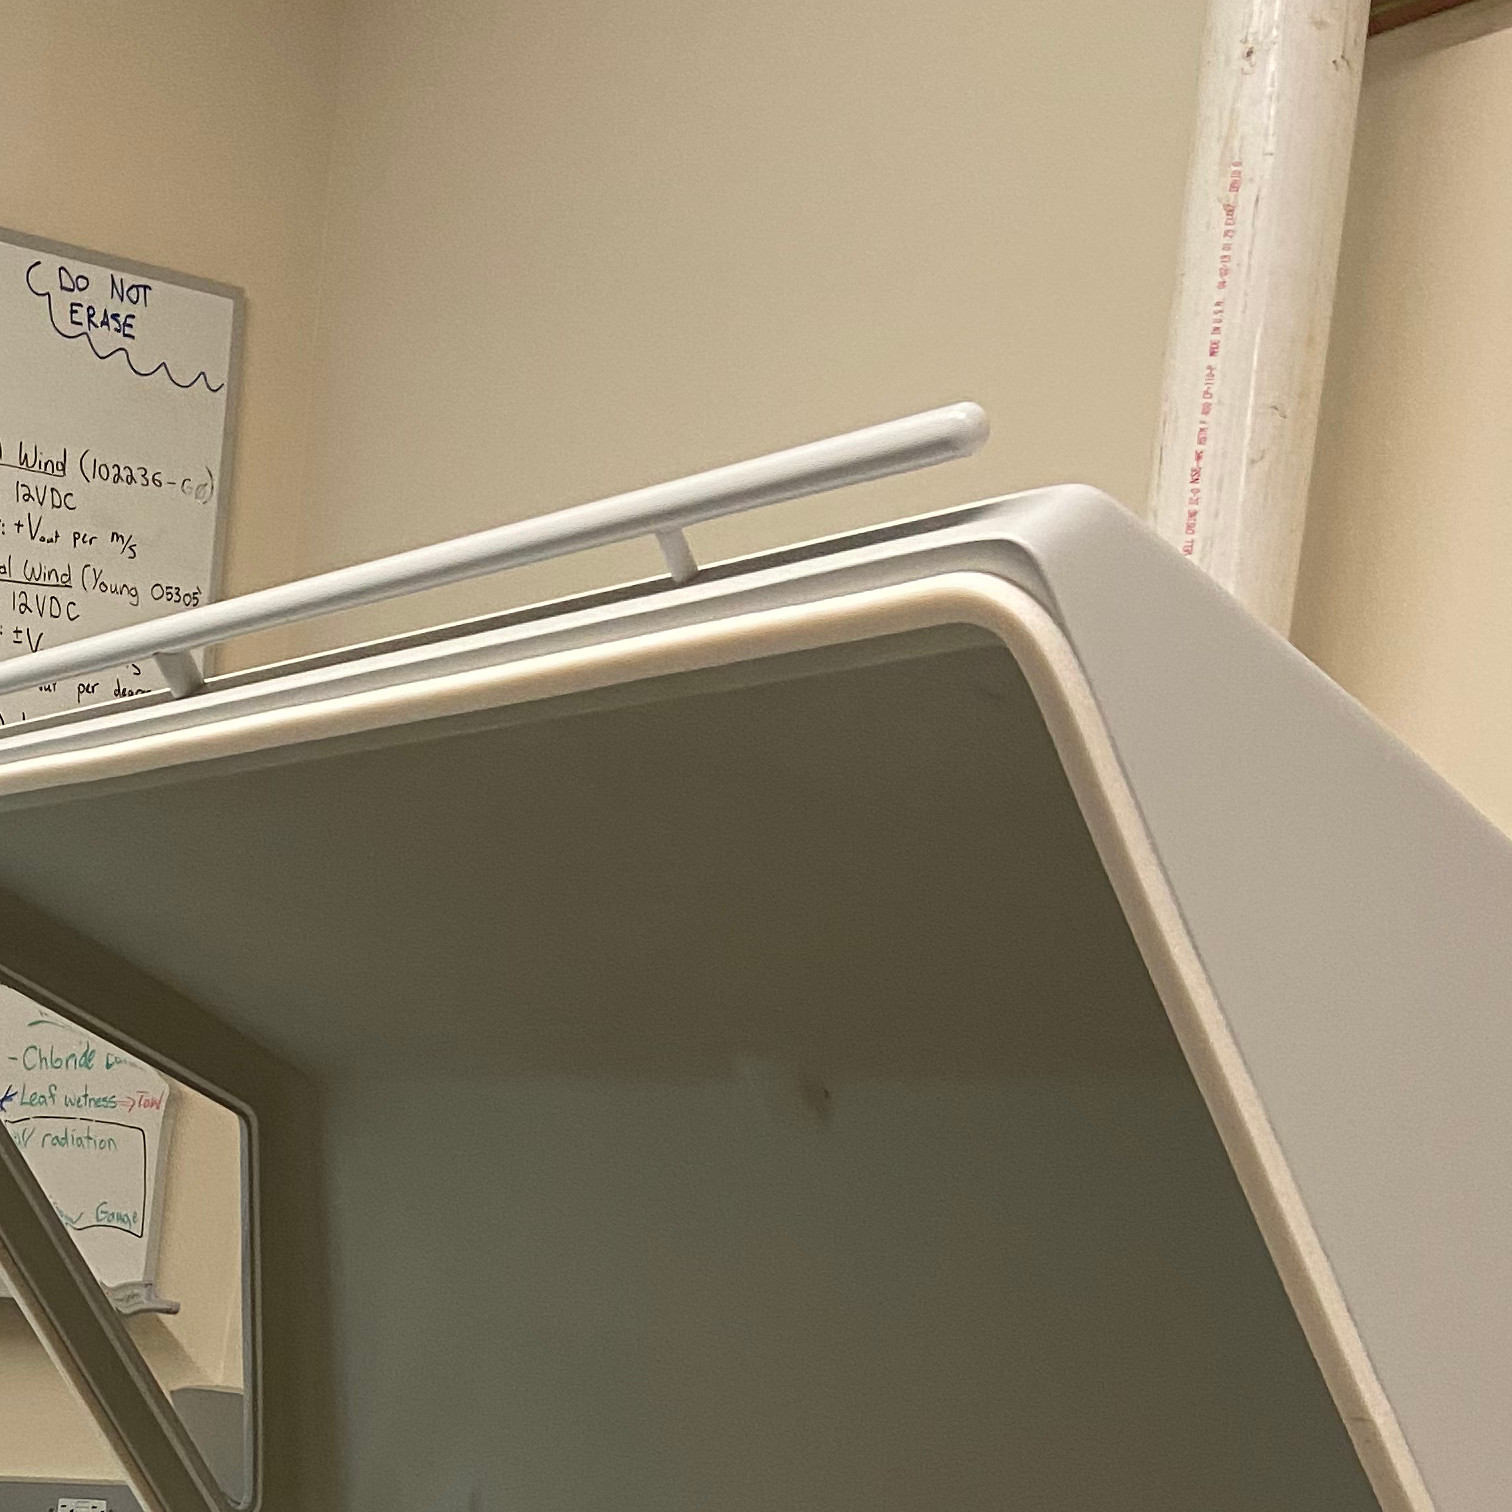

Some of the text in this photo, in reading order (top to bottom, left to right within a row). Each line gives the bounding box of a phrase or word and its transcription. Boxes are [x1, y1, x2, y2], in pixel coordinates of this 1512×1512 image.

[59, 266, 152, 307] DO NOT
[69, 302, 136, 339] ERASE
[18, 441, 67, 474] Wind
[15, 481, 77, 511] 12VDC
[72, 532, 97, 546] per
[110, 531, 137, 559] m/s
[23, 559, 72, 585] Wind
[82, 564, 139, 606] (Young
[12, 590, 80, 621] 12VDC
[78, 683, 99, 703] per
[20, 1084, 57, 1107] Leaf
[41, 1126, 117, 1150] radiation
